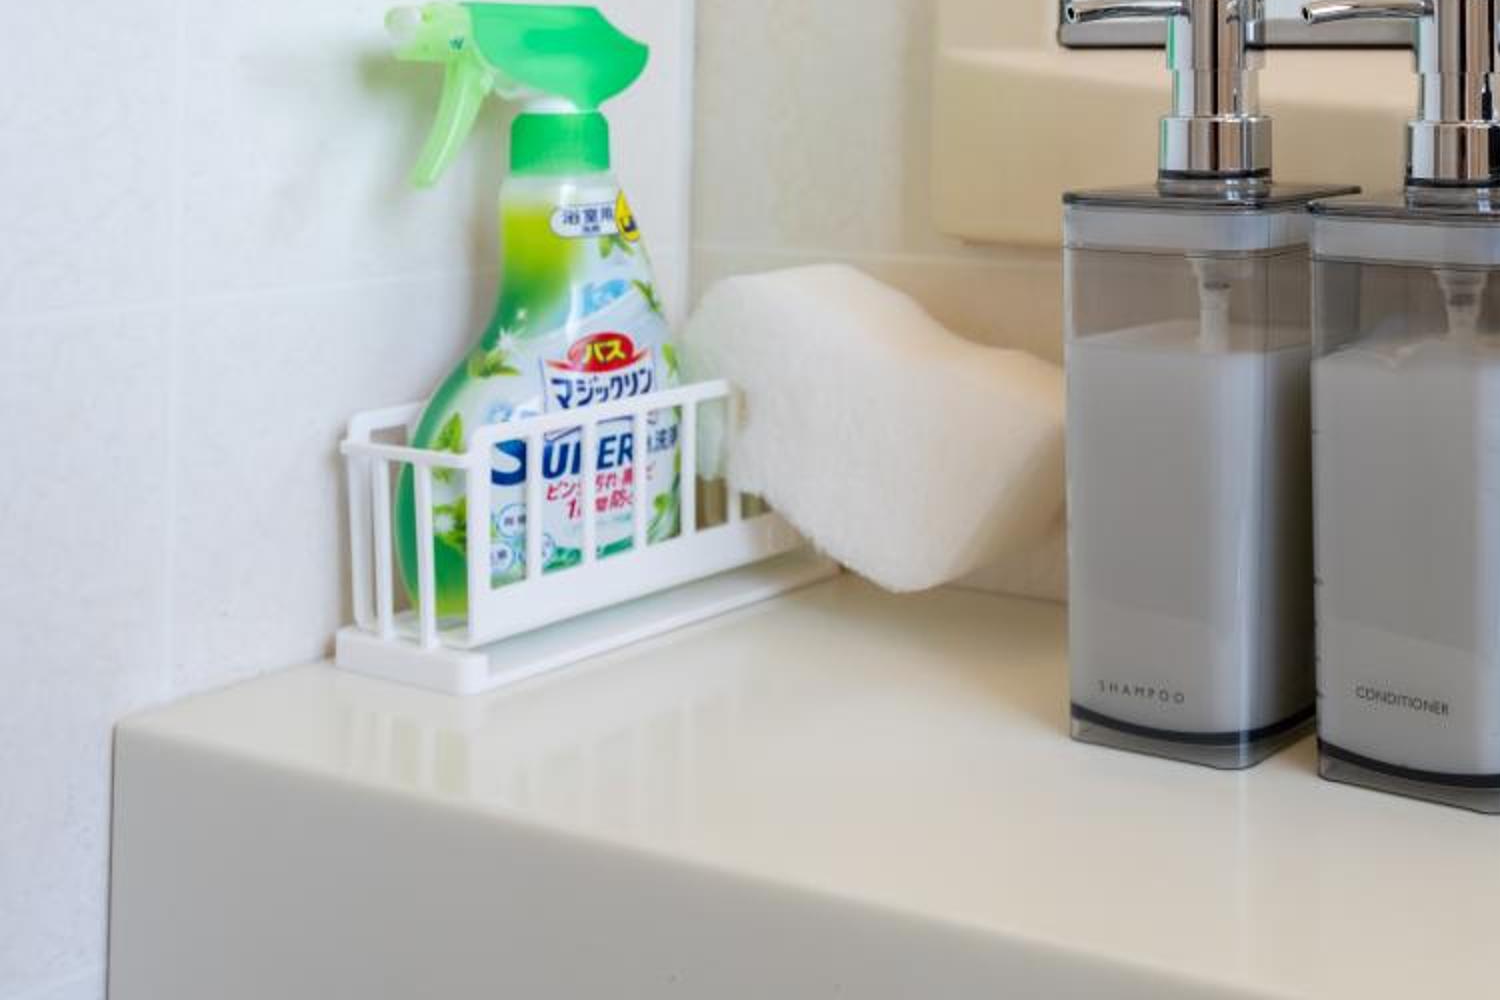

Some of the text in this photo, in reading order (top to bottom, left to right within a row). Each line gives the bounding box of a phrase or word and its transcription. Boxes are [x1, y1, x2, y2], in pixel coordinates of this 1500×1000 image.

[583, 340, 626, 364] バス
[551, 368, 652, 409] マジックリン
[1098, 679, 1185, 704] SHAMPOO
[1356, 686, 1449, 716] CONDITIONER
